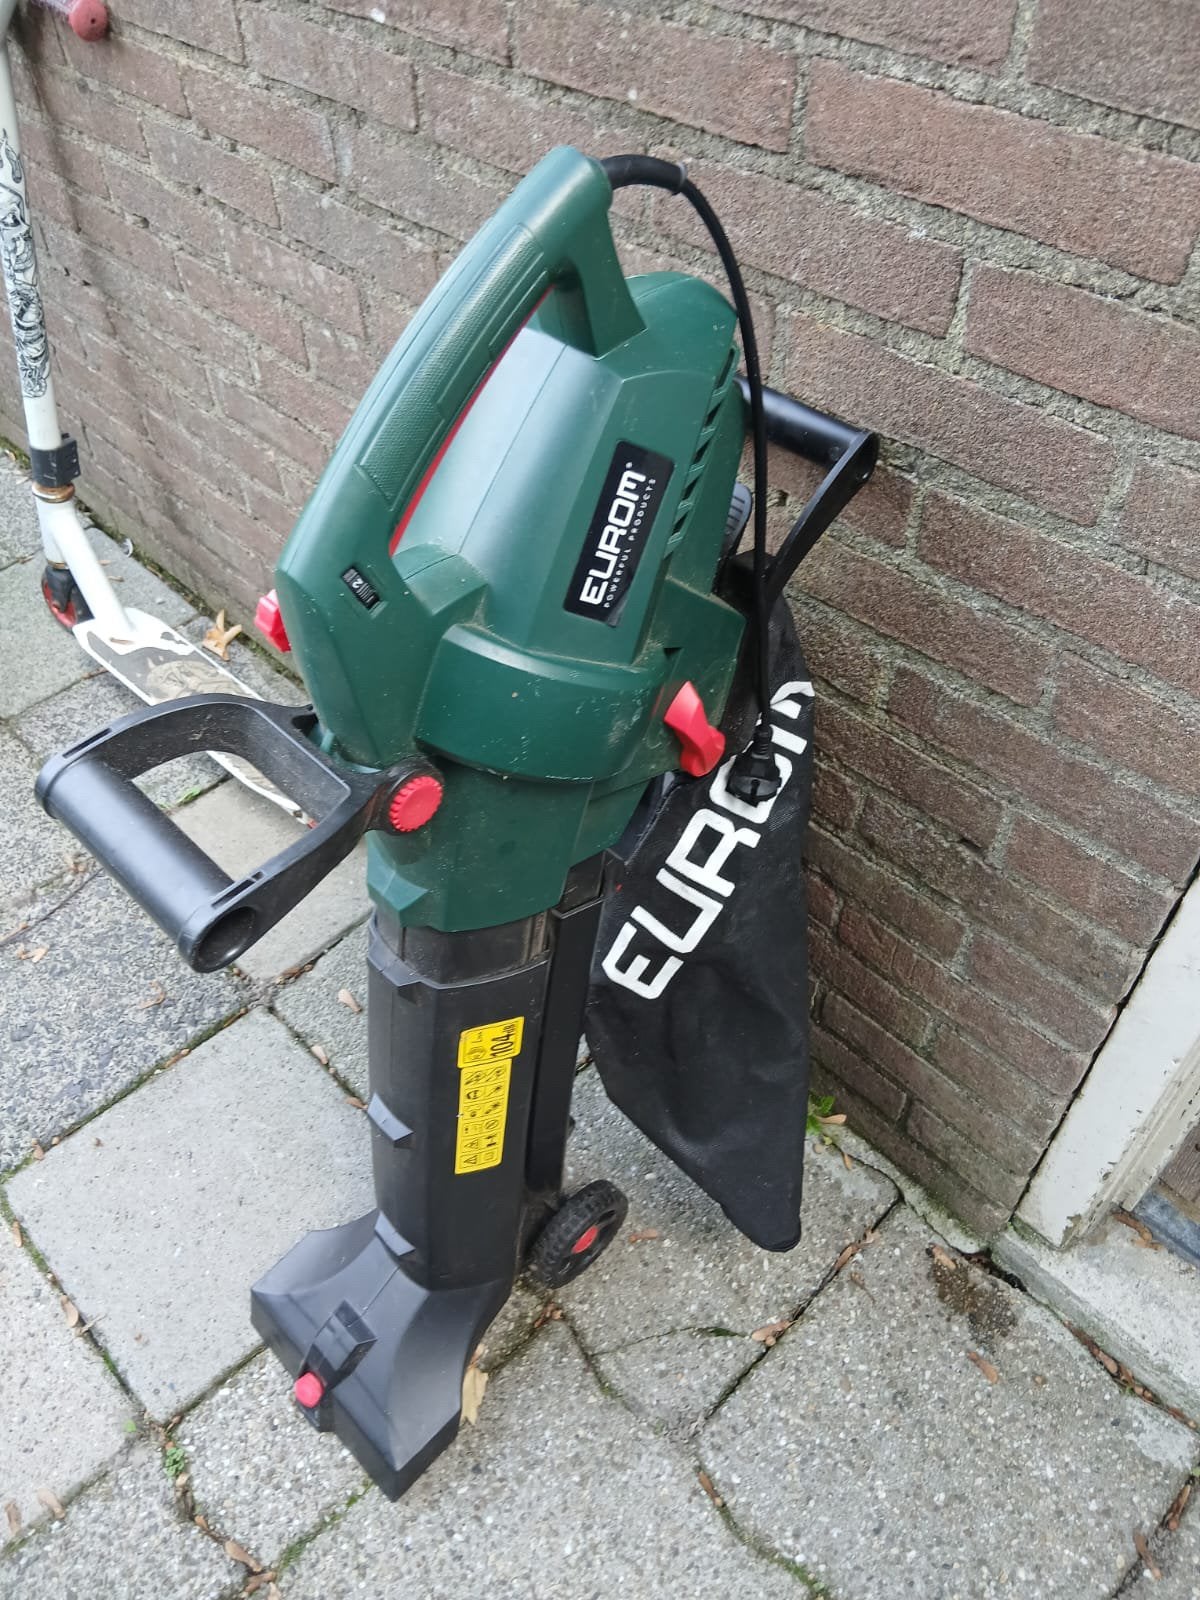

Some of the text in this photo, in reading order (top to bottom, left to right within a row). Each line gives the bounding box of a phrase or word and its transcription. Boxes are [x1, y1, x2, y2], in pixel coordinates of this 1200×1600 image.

[351, 577, 364, 589] 2
[579, 469, 647, 606] EUROM
[603, 478, 657, 609] POWERFUL PRODUCTS
